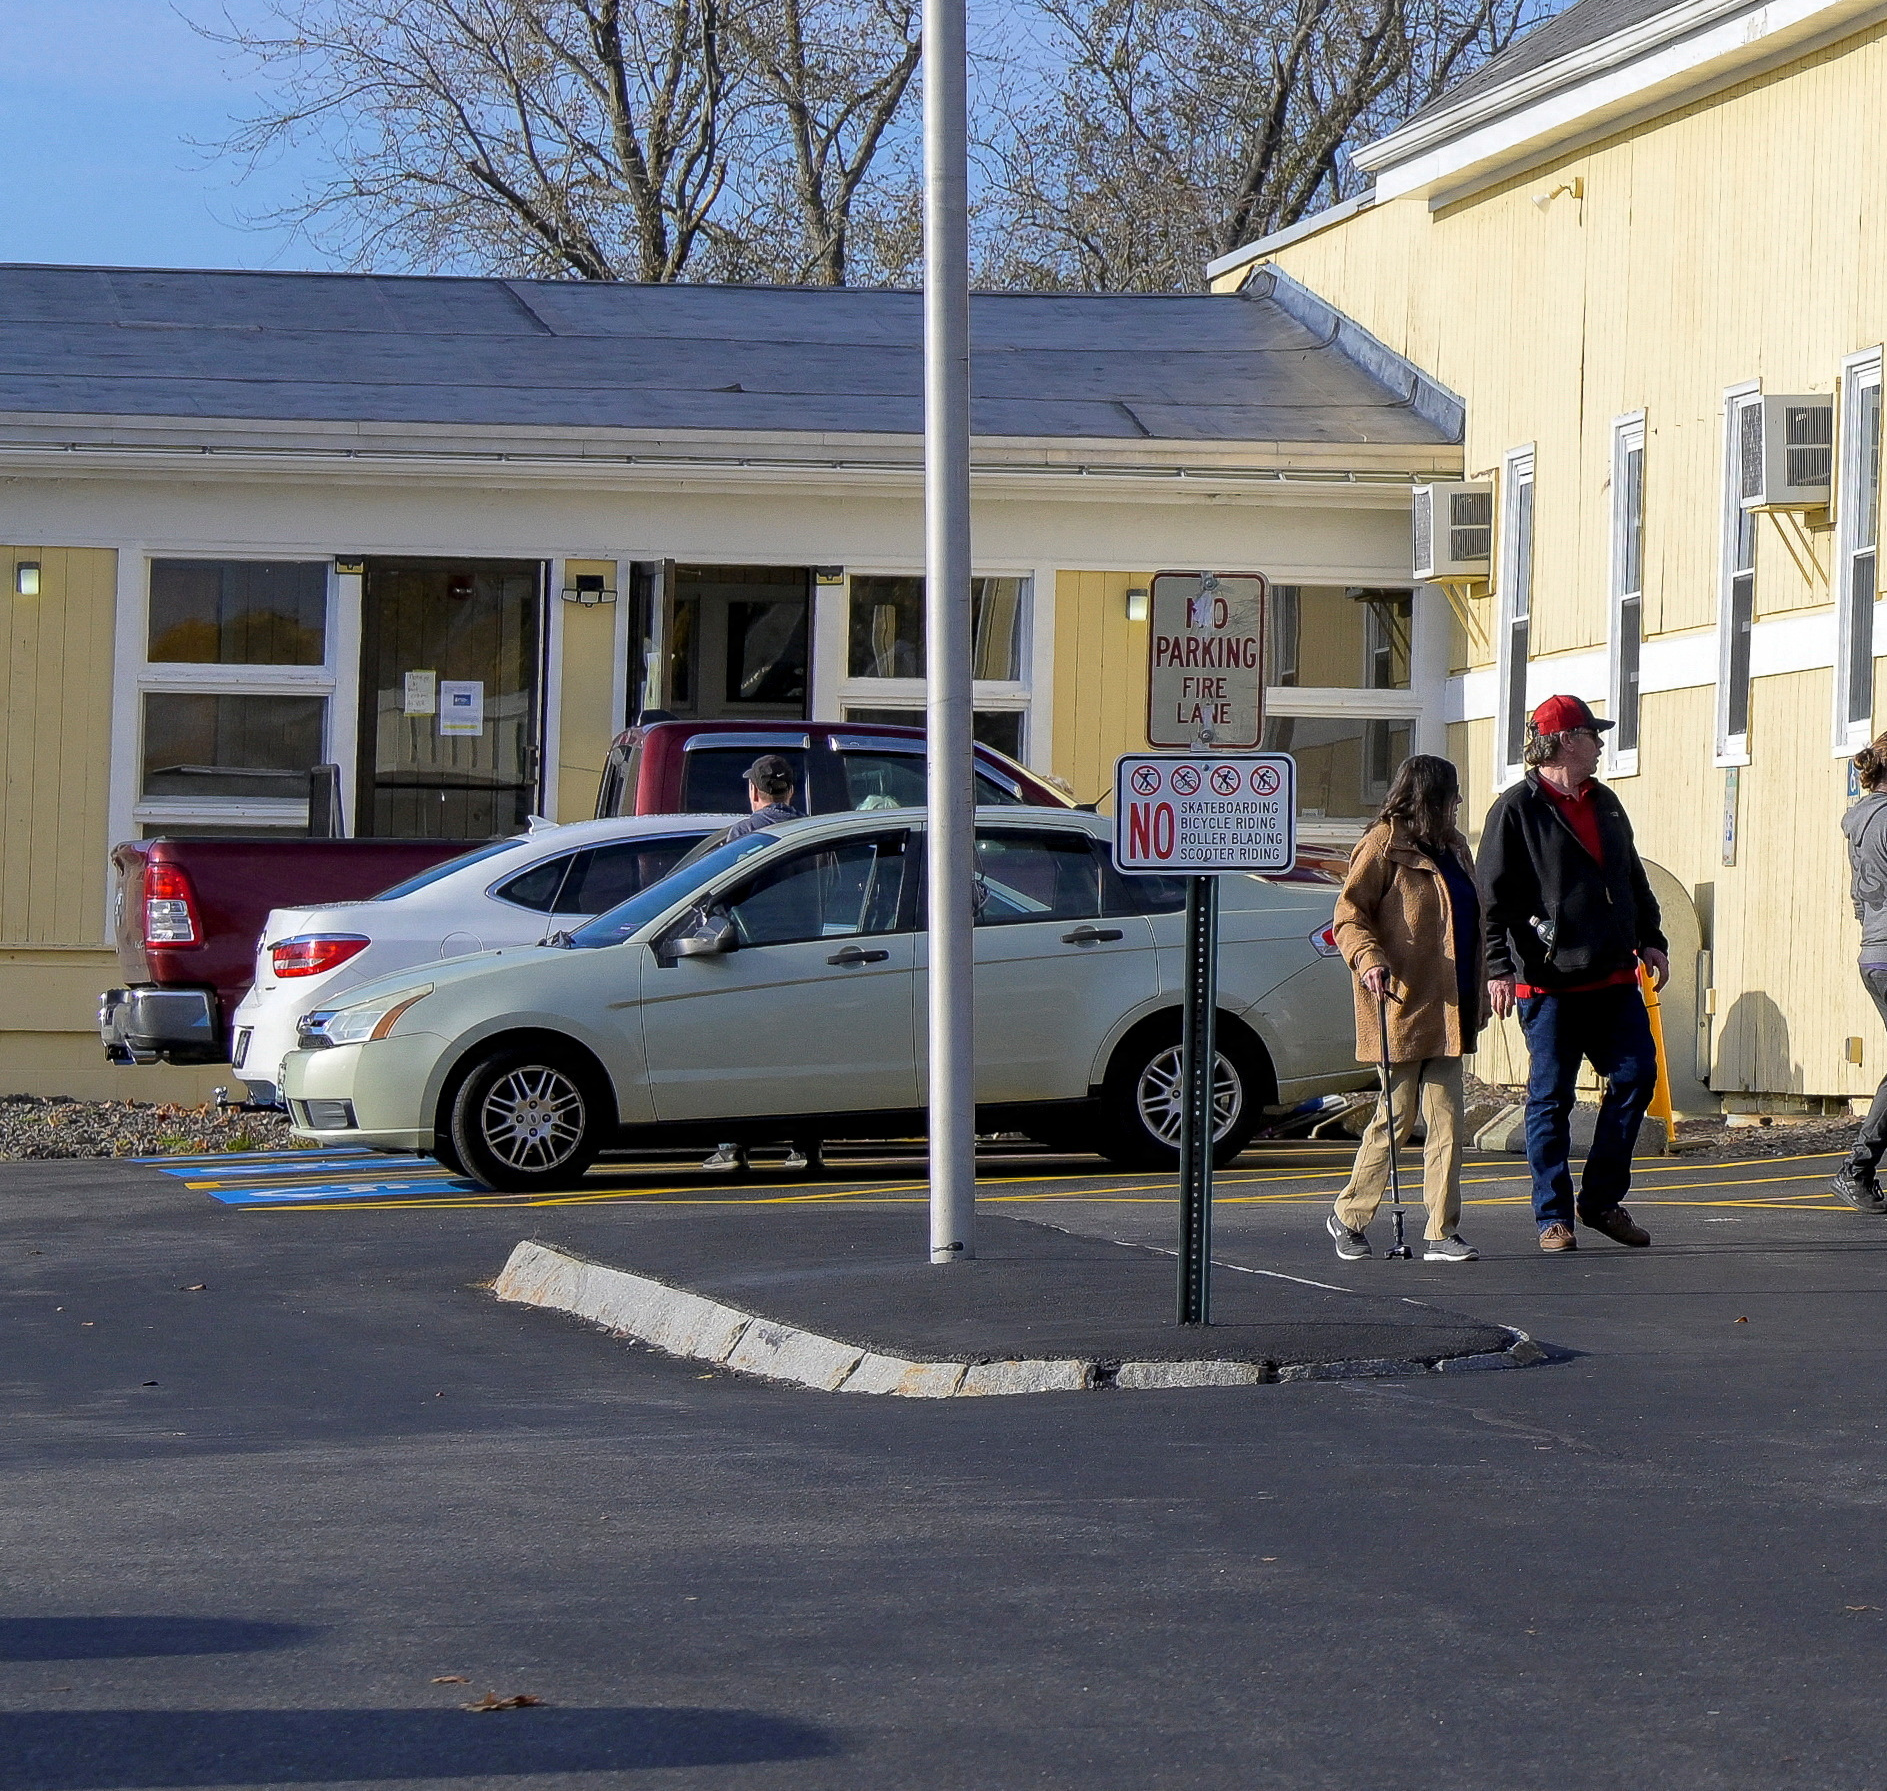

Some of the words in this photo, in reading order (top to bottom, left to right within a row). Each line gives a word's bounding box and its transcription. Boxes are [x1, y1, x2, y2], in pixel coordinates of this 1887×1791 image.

[1155, 635, 1257, 669] PARKING
[1182, 676, 1228, 699] FIRE
[1177, 702, 1232, 725] LANE
[1180, 801, 1279, 814] SKATEBOARDING
[1129, 801, 1175, 860] NO
[1180, 817, 1231, 829] BICYCLE
[1236, 817, 1276, 829] RIDING
[1180, 832, 1227, 845] ROLLER
[1231, 832, 1283, 845] BLADING
[1180, 848, 1235, 860] SCOOTER
[1239, 848, 1280, 861] RIDING
